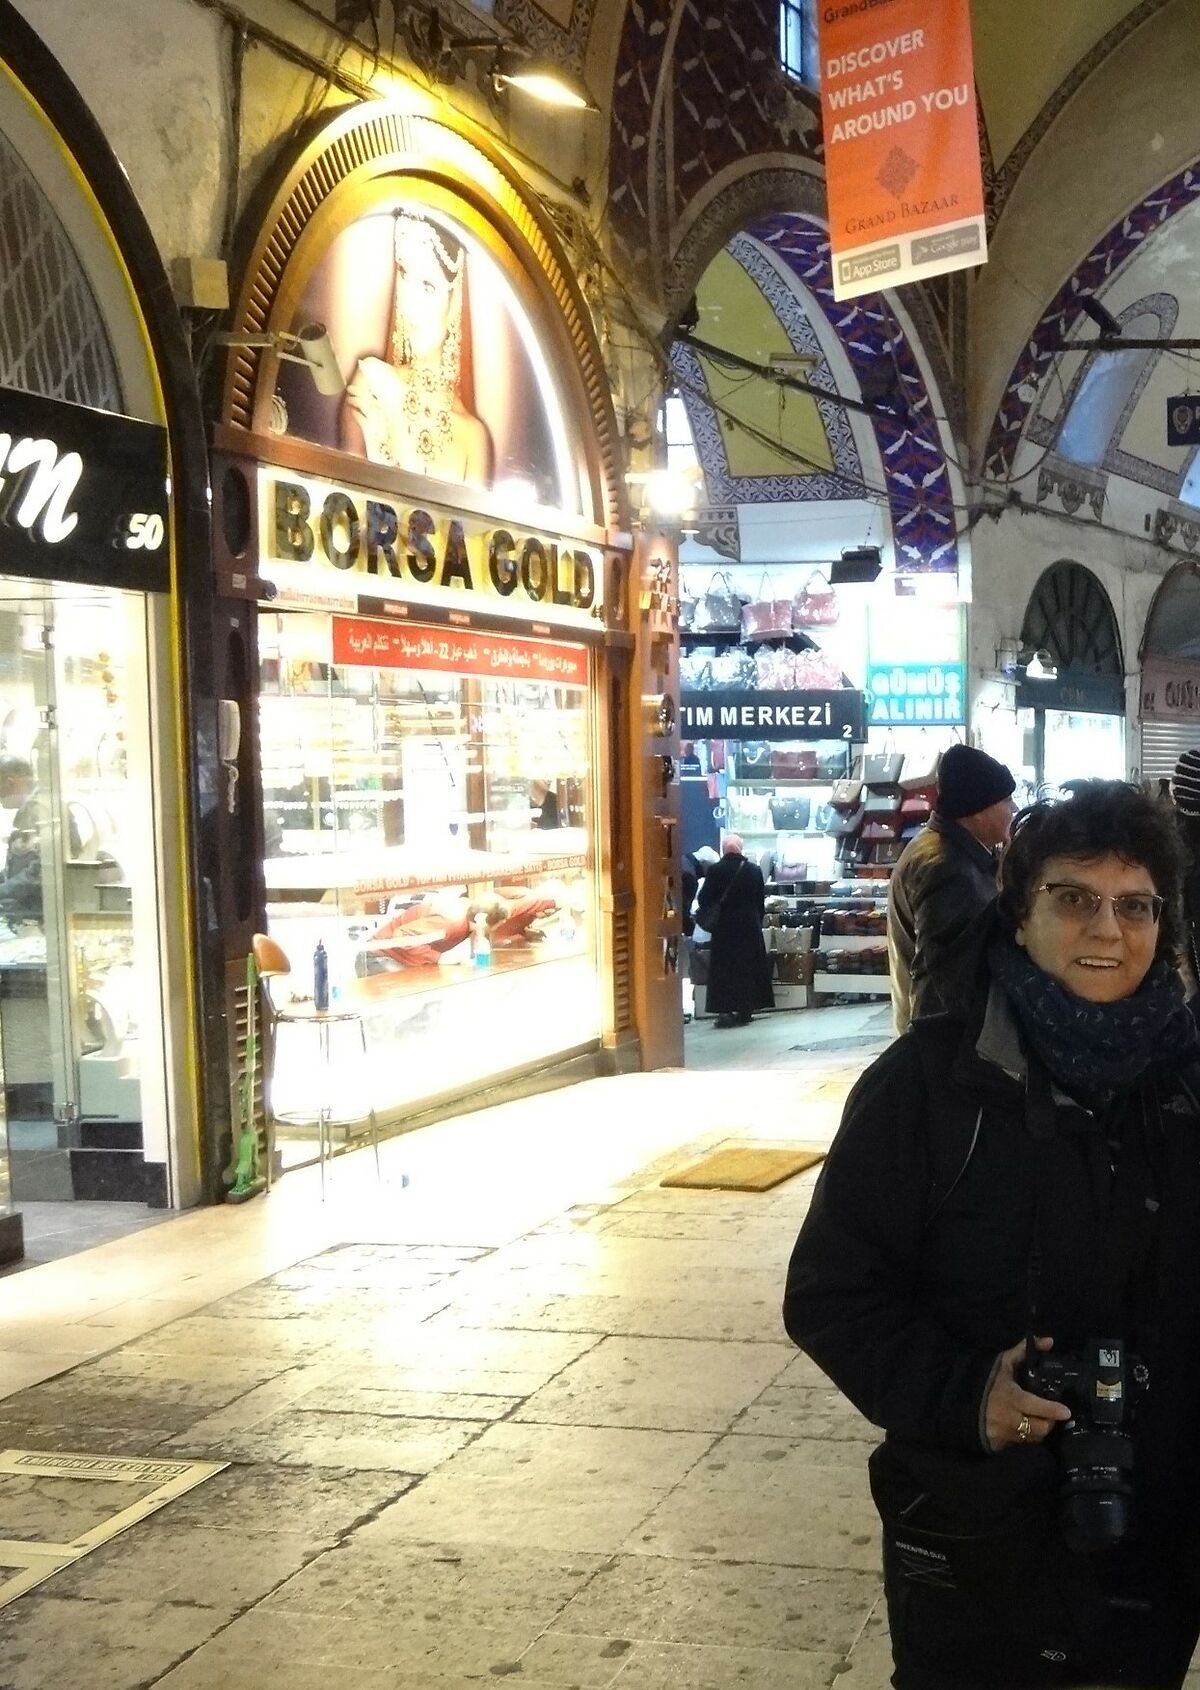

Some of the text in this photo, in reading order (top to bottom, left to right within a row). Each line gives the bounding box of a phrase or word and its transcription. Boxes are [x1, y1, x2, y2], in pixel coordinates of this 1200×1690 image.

[826, 29, 925, 80] DISCOVER
[828, 70, 904, 110] WHAT'S
[830, 84, 969, 144] AROUND YOU
[930, 238, 960, 254] Google
[852, 256, 898, 280] App Store
[125, 512, 165, 551] 50
[272, 480, 474, 591] BORSA
[488, 528, 595, 609] GOLD
[871, 665, 961, 698] GÜMÜŞ
[720, 702, 832, 727] MERKEZİ
[871, 697, 961, 721] ALINIR
[842, 724, 853, 739] 2
